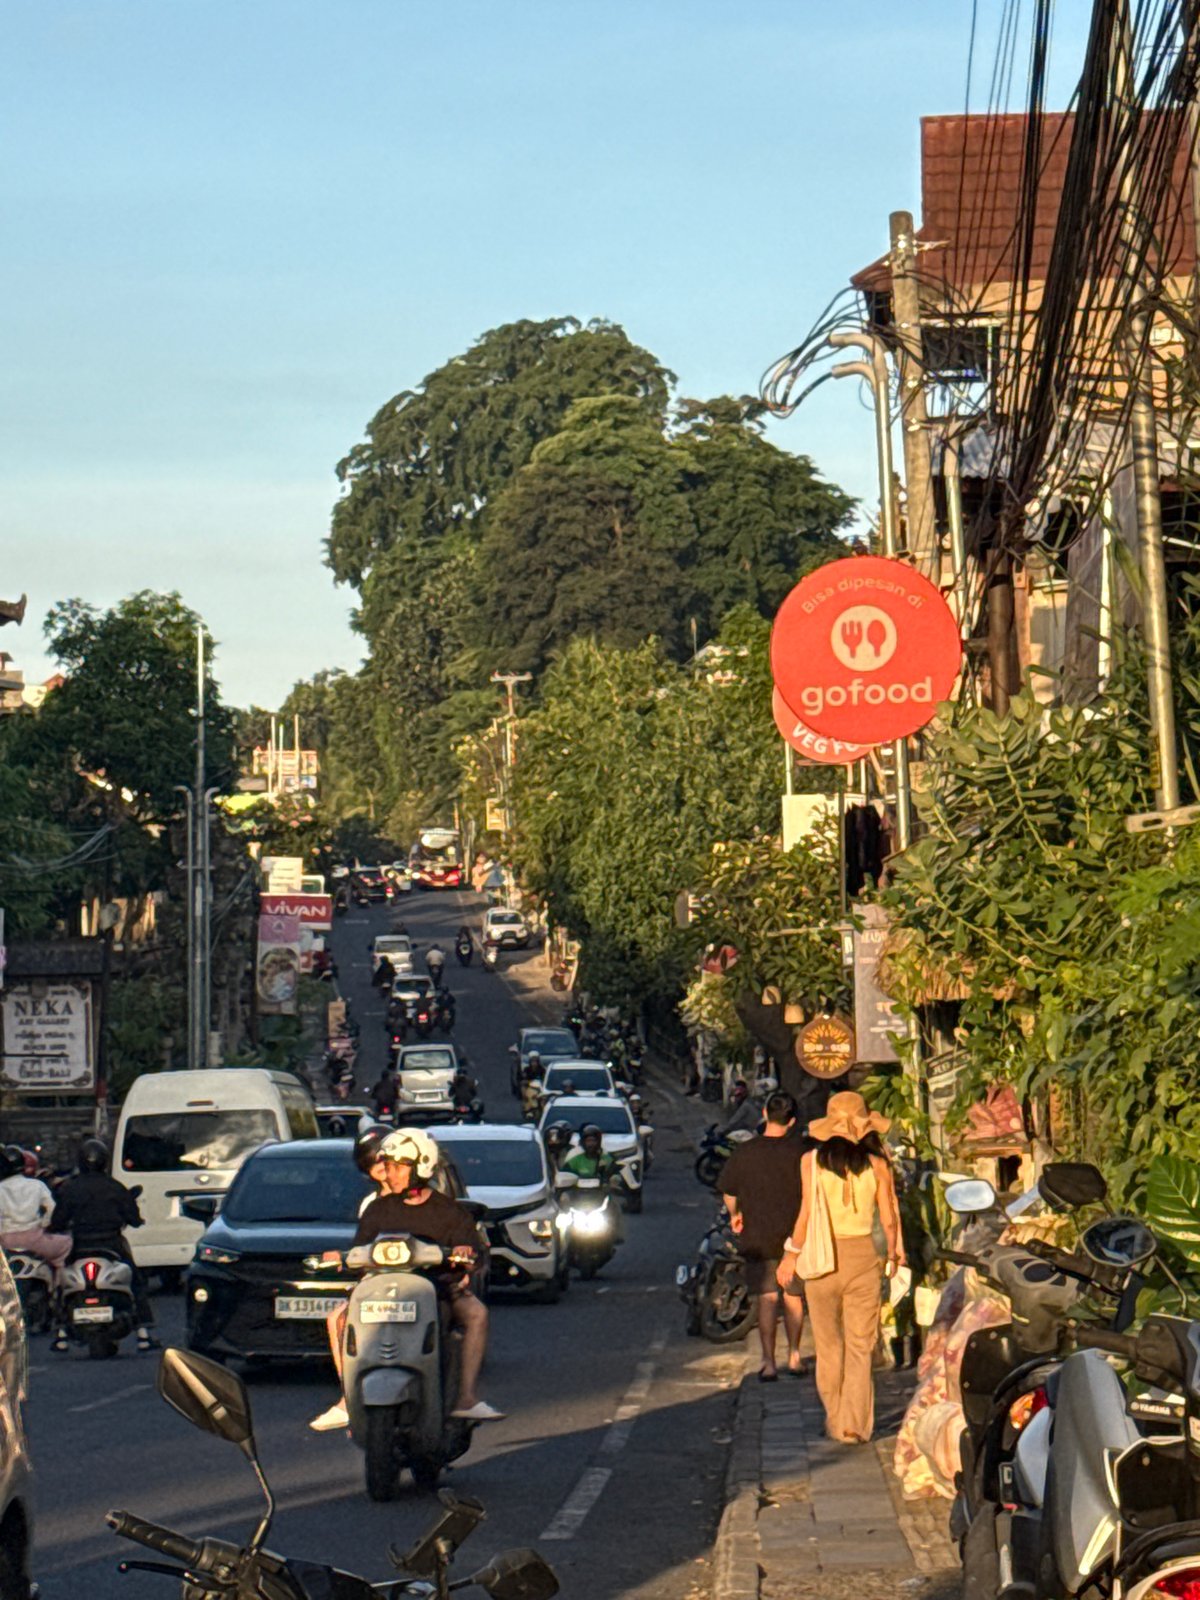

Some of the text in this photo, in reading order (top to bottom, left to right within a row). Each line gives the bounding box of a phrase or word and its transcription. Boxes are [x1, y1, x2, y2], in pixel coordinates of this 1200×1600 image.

[801, 577, 926, 614] Bisa dipesan di
[801, 676, 933, 716] gofood
[792, 721, 828, 754] VEG
[14, 999, 74, 1016] NEKA
[1139, 1403, 1171, 1415] YAMAHA
